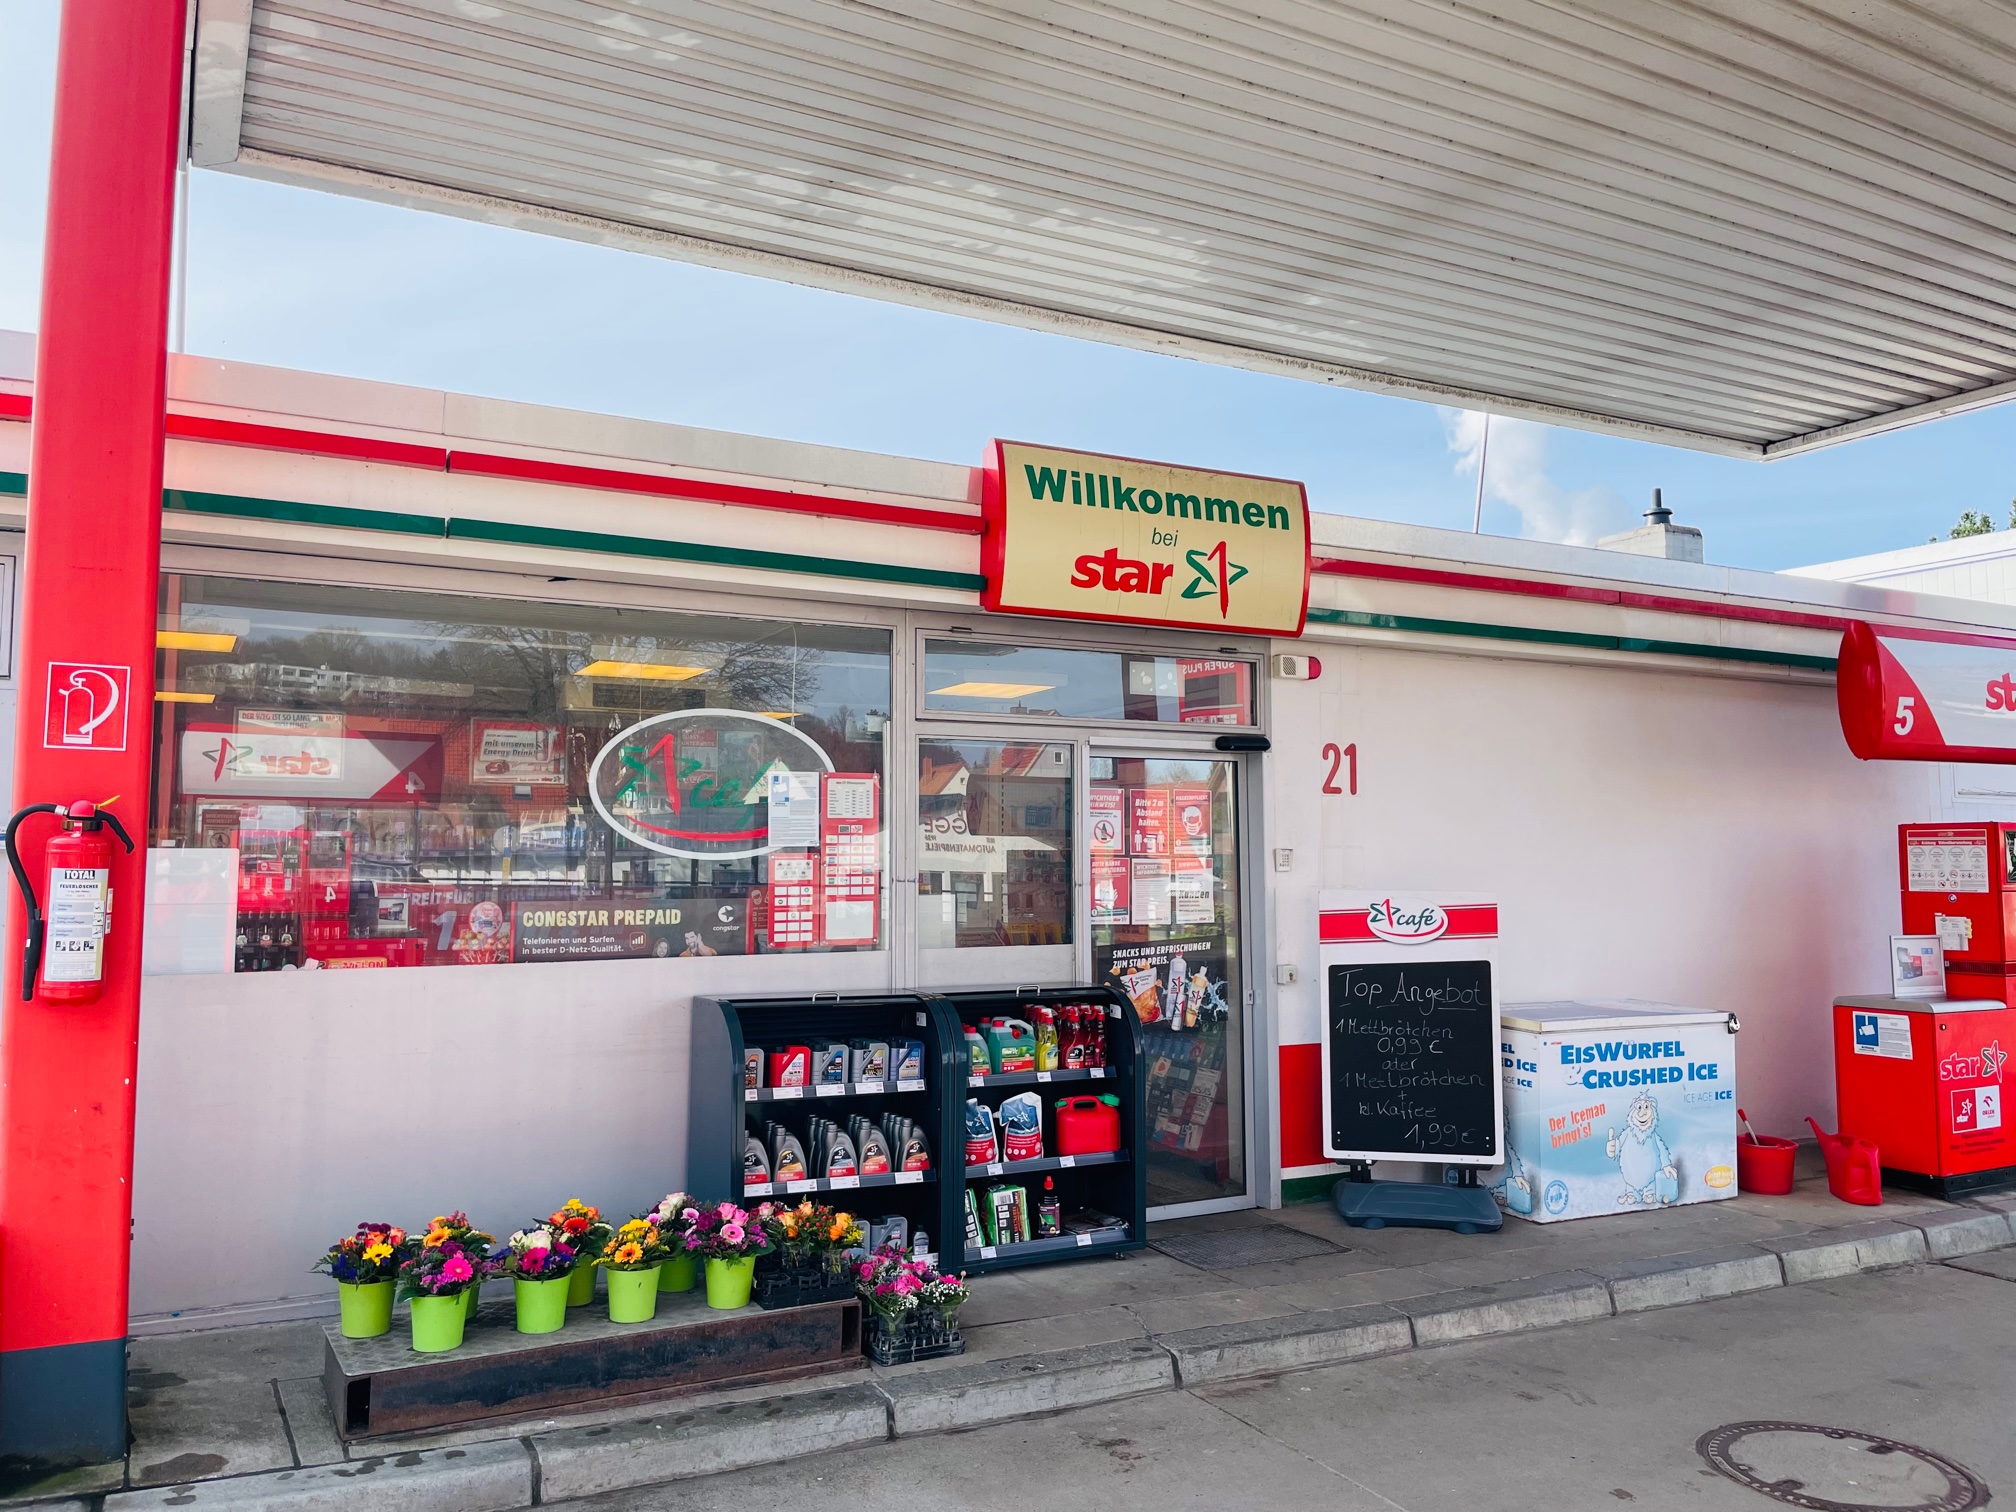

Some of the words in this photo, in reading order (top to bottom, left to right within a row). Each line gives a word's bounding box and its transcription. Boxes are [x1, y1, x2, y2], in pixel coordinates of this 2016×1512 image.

[1023, 464, 1290, 530] Willkommen
[1151, 527, 1178, 547] bei
[1070, 547, 1174, 595] star
[1986, 672, 2016, 711] st
[1894, 696, 1914, 735] 5
[1322, 742, 1357, 795] 21
[1135, 798, 1150, 807] Bitte
[1136, 808, 1163, 817] Abstand
[1138, 818, 1160, 827] halten.
[66, 870, 95, 880] TOTAL
[522, 910, 609, 928] CONGSTAR
[614, 908, 681, 926] PREPAID
[1396, 907, 1437, 934] café
[713, 924, 740, 933] congstar
[522, 947, 530, 955] in
[532, 946, 558, 955] bester
[560, 944, 624, 954] D-Netz-Qualität.
[523, 936, 570, 946] Telefonieren
[572, 936, 587, 945] und
[589, 935, 615, 944] Surfen
[1112, 948, 1140, 959] SNACKS
[1141, 946, 1155, 956] UND
[1156, 942, 1211, 955] ERFRISCHUNGEN
[1112, 960, 1128, 969] ZUM
[1129, 958, 1147, 968] STAR
[1149, 955, 1170, 965] PREIS.
[1337, 968, 1383, 1005] Top
[1390, 971, 1489, 1016] Angebot
[1377, 1037, 1422, 1055] 0,99
[1429, 1040, 1443, 1054] €
[1382, 1057, 1418, 1070] oder
[1516, 1058, 1538, 1073] ICE
[1940, 1052, 1980, 1080] star
[1517, 1078, 1533, 1088] ICE
[1582, 1066, 1684, 1090] CRUSHED
[1688, 1062, 1718, 1081] ICE
[1683, 1093, 1696, 1104] ICE
[1698, 1091, 1713, 1102] AGE
[1715, 1090, 1733, 1100] ICE
[1376, 1099, 1437, 1120] Kaffee
[1549, 1116, 1567, 1132] Der
[1571, 1103, 1606, 1125] Iceman
[1404, 1123, 1458, 1151] 1,99
[1551, 1121, 1592, 1149] bringt's!
